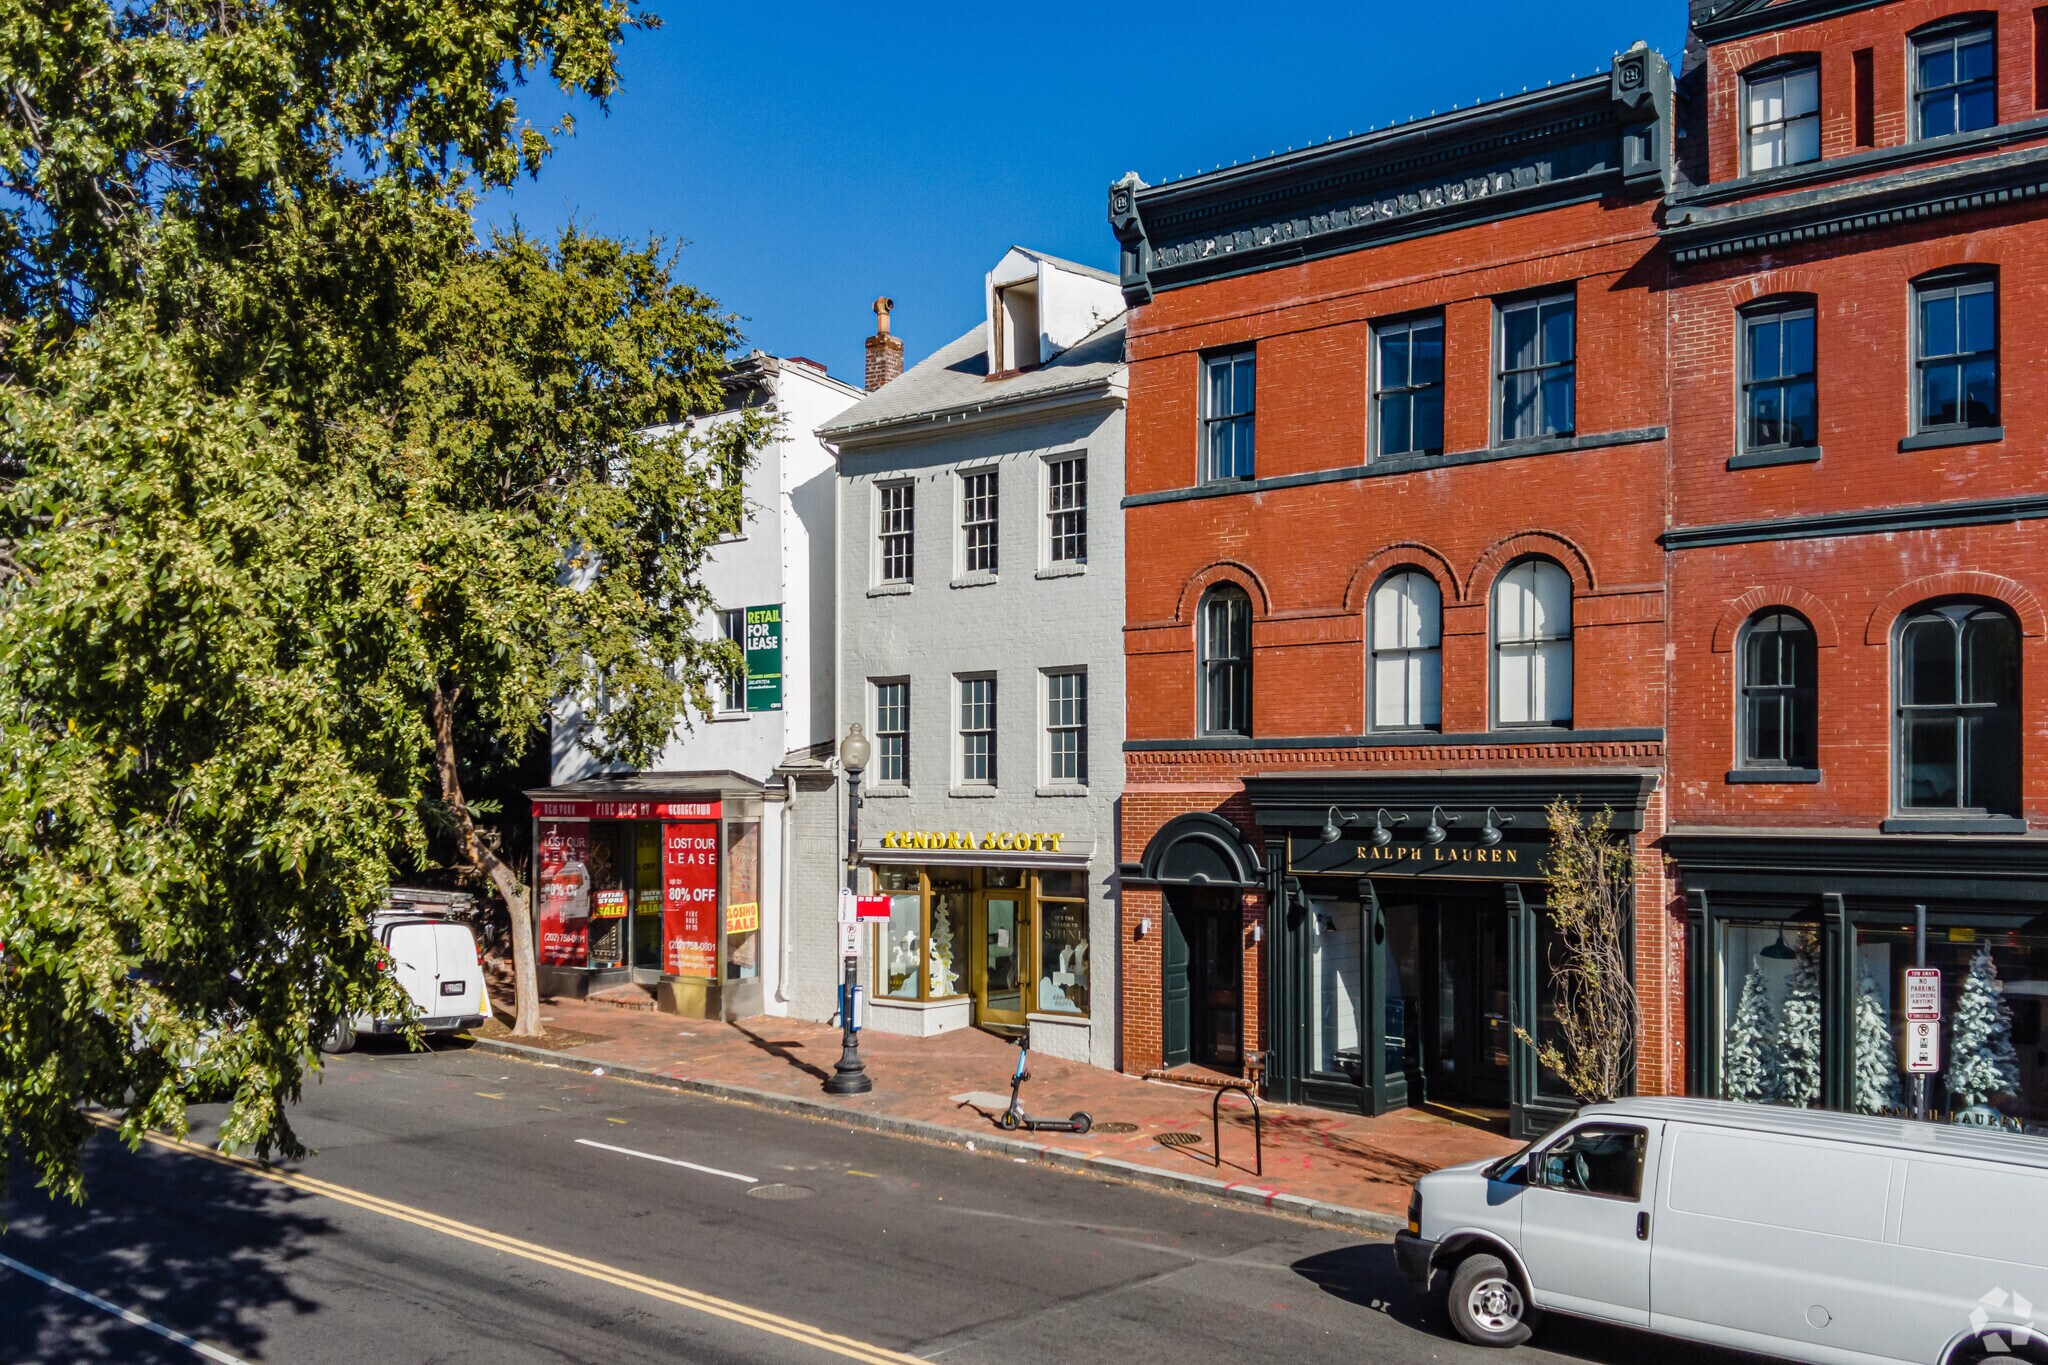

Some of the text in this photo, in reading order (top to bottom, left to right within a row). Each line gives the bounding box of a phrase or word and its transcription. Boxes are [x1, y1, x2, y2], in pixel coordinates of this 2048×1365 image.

[748, 610, 781, 623] RETAIL
[748, 624, 769, 637] FOR
[748, 636, 778, 650] LEASE
[668, 803, 711, 816] GEORGETOWN
[544, 836, 586, 848] LOST OUR
[669, 837, 692, 849] LOST
[694, 838, 715, 849] OUR
[884, 831, 1064, 852] KENDRA SCOTT
[668, 853, 715, 865] LEASE
[1357, 846, 1517, 862] RALPH LAUREN
[669, 887, 691, 901] 80%
[693, 888, 716, 902] OFF
[596, 905, 626, 916] SALE!
[726, 917, 755, 931] SALE
[544, 933, 559, 942] (202)
[1880, 1104, 2024, 1133] RALH LAUREN
